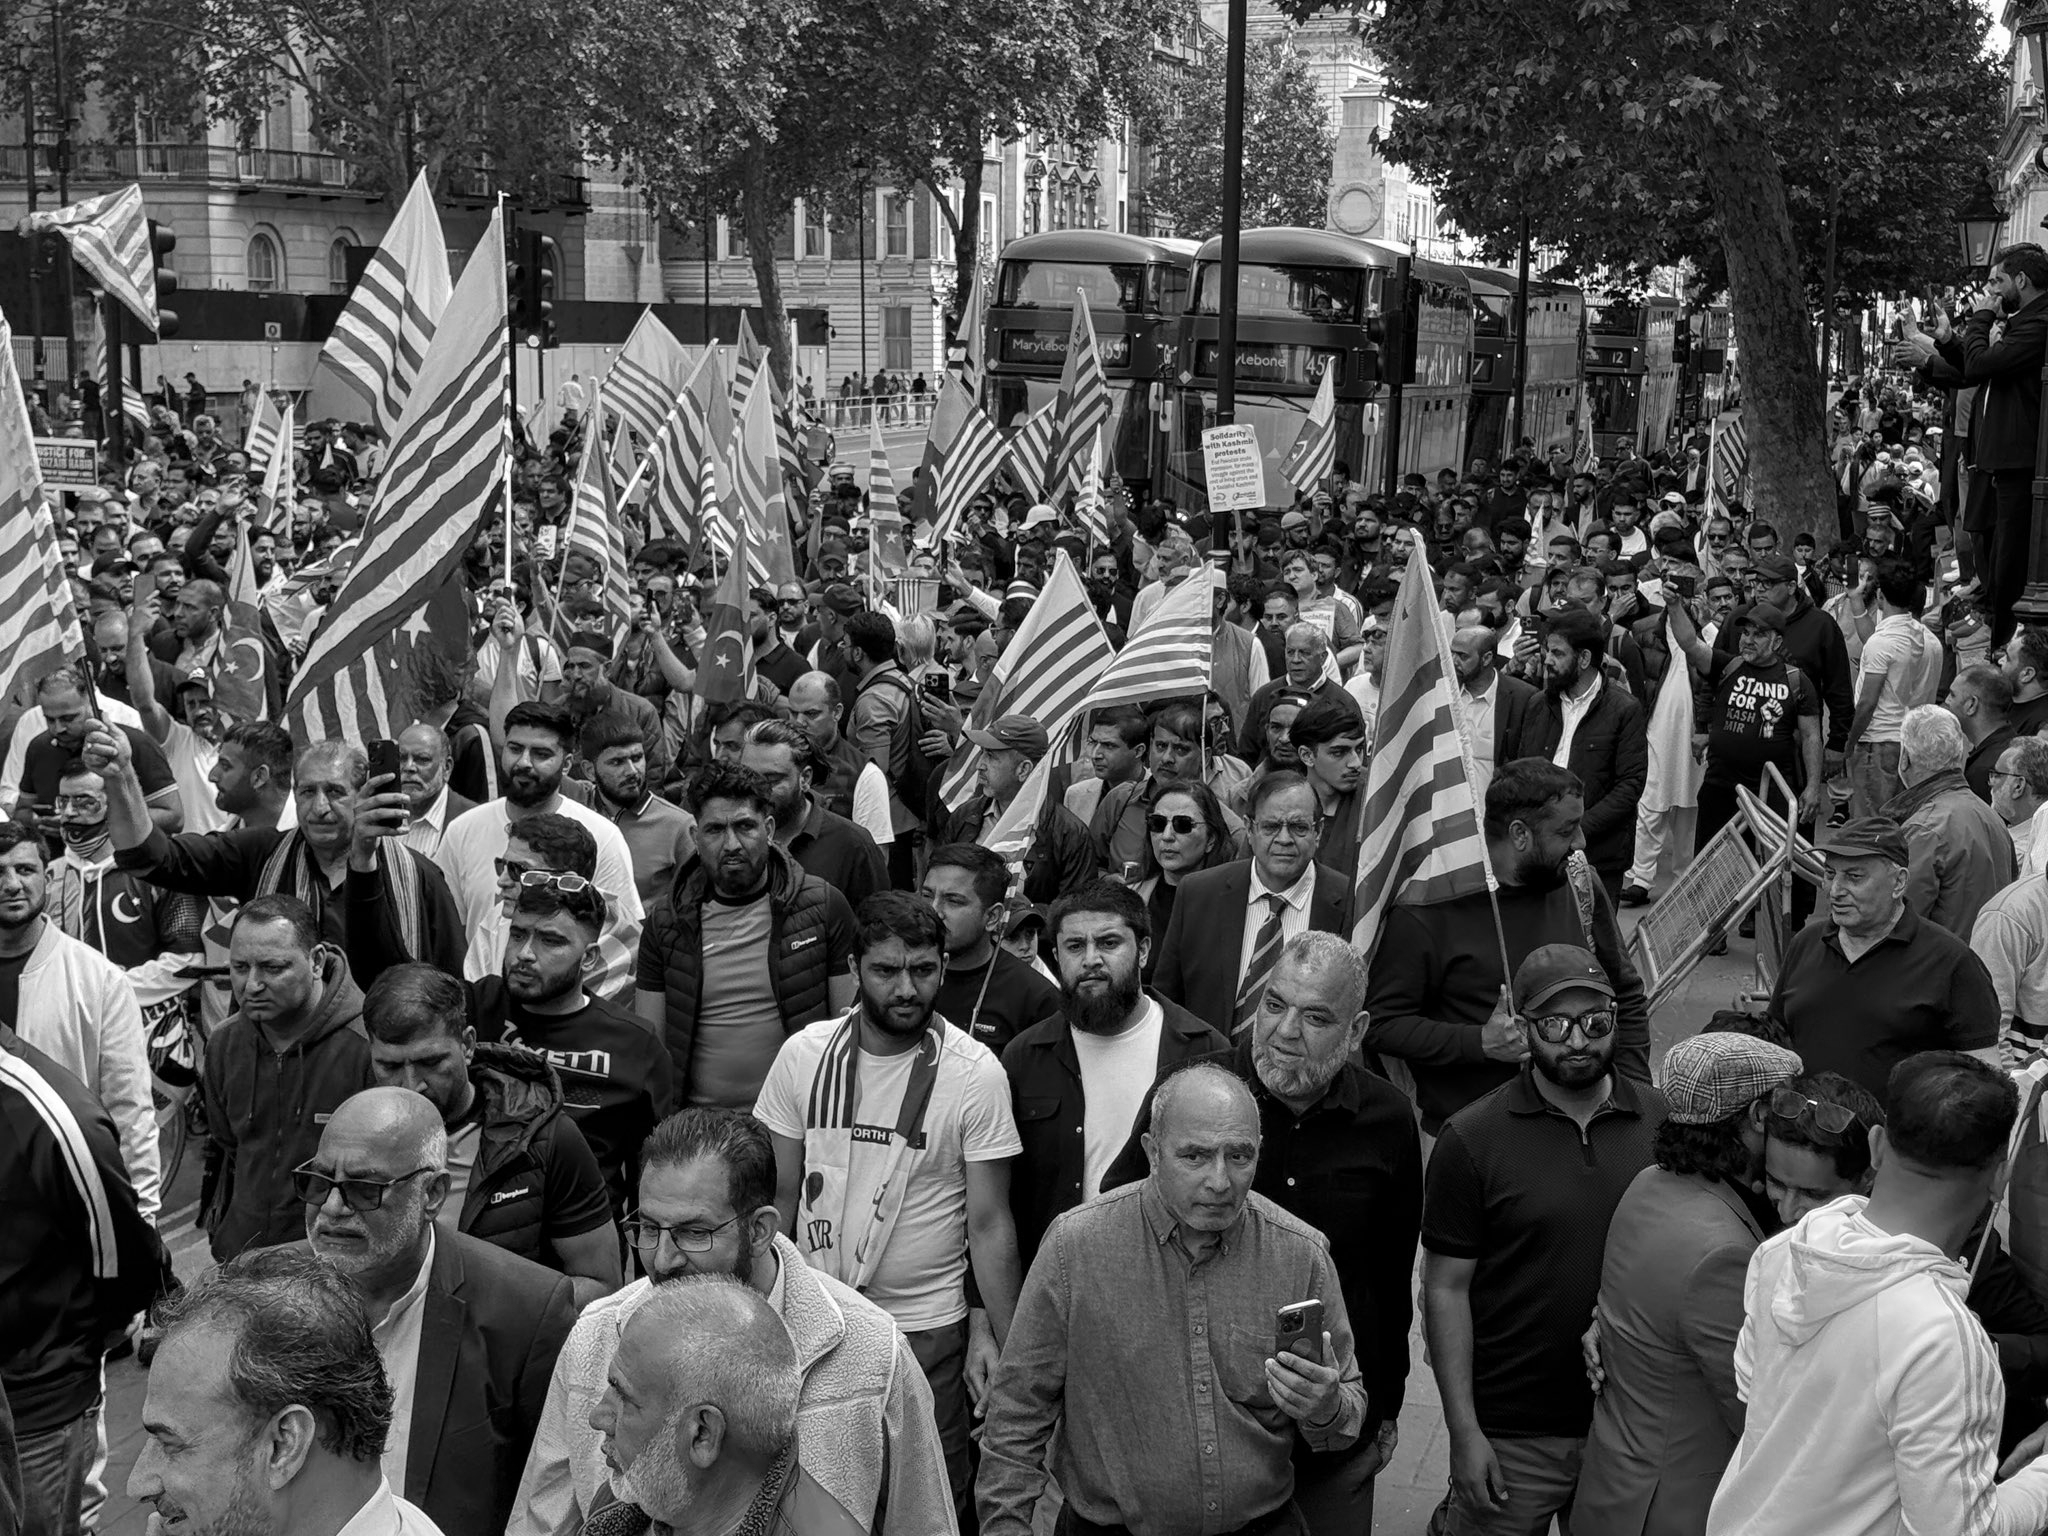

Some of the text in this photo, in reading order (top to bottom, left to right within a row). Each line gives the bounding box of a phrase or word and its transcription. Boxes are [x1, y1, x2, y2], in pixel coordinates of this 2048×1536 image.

[1013, 338, 1070, 353] Marylebo
[1210, 350, 1332, 376] Mylebone 45
[1612, 351, 1624, 364] 12
[1210, 431, 1246, 440] Solidarity
[1222, 438, 1253, 447] Kashmir
[36, 446, 86, 459] USTICE FOR
[1215, 448, 1246, 458] protests
[1733, 675, 1789, 700] STAND
[1728, 691, 1757, 711] FOR
[1726, 707, 1756, 723] KASH
[1723, 720, 1745, 733] MIR
[853, 1127, 886, 1141] ORTH
